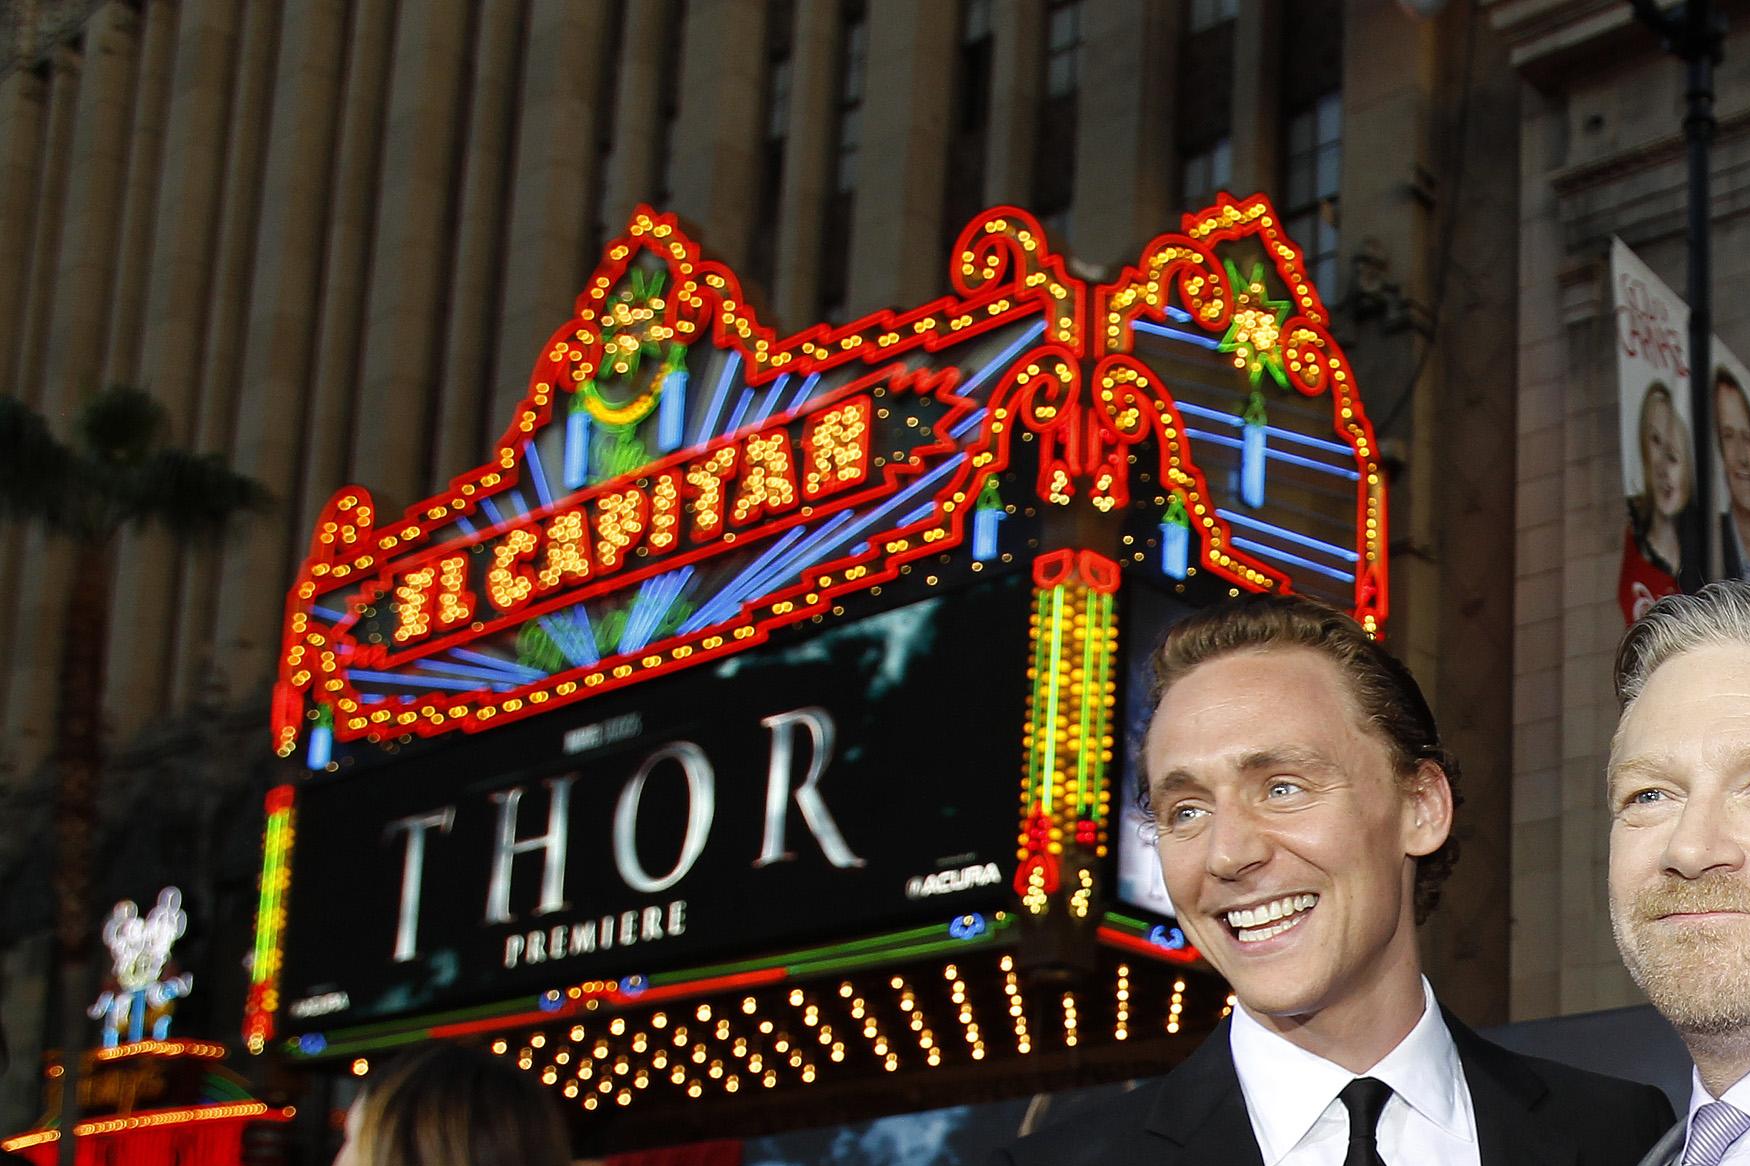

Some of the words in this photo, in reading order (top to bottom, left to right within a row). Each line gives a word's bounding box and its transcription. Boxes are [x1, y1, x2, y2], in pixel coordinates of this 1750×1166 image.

[393, 550, 476, 646] EL
[485, 395, 873, 614] CAPITAN
[382, 706, 867, 964] THOR
[920, 861, 1002, 898] ACURA
[504, 899, 689, 970] PREMIERE
